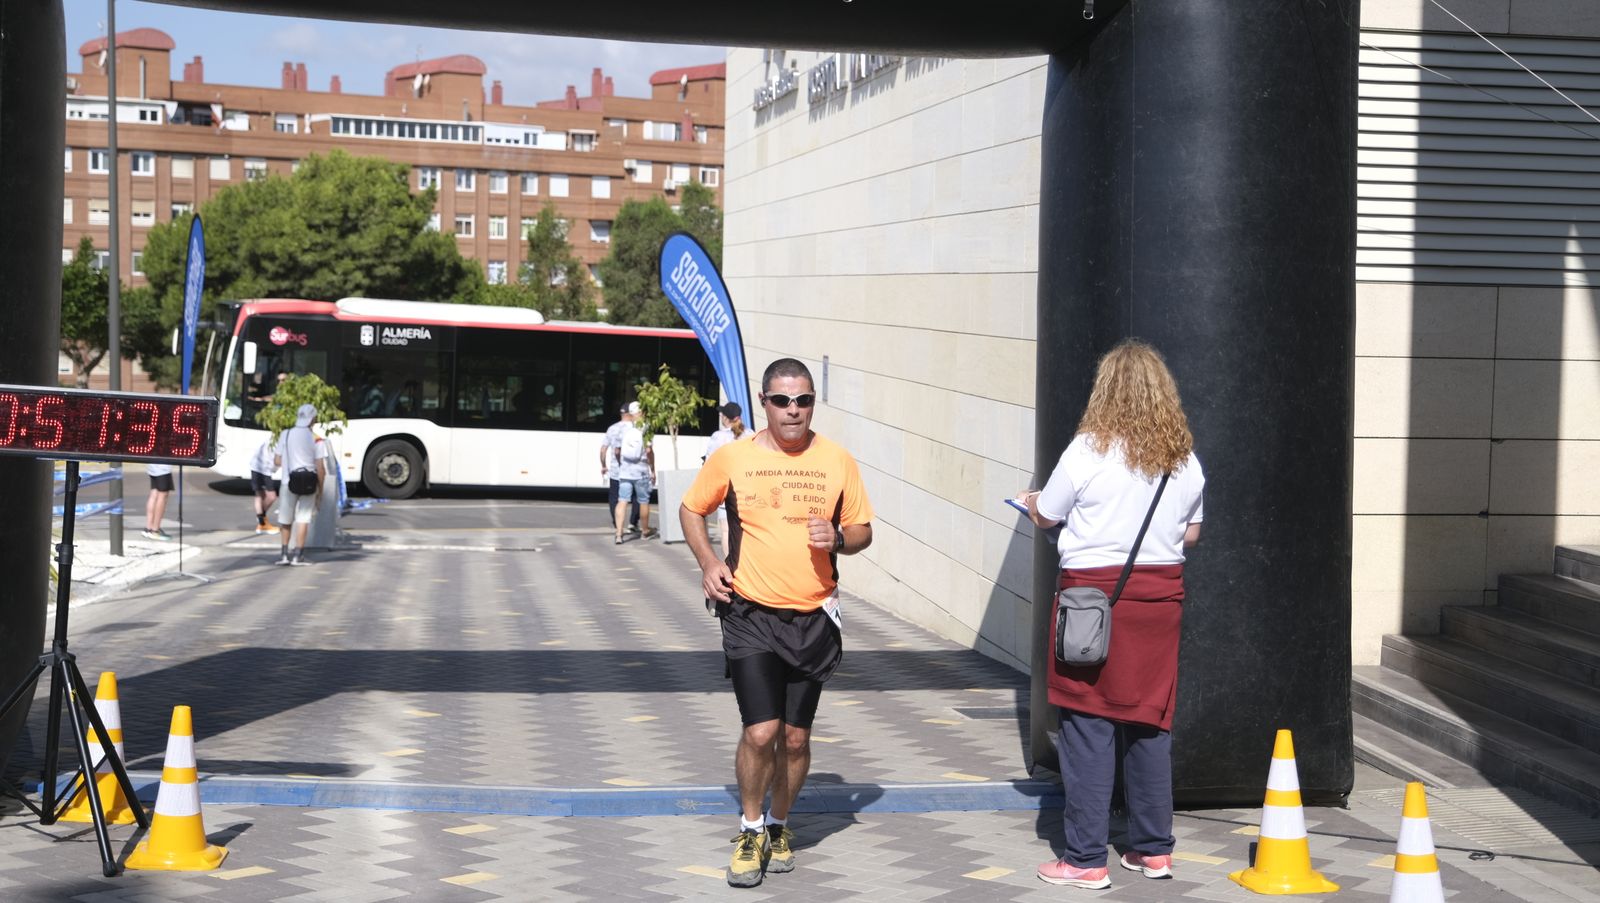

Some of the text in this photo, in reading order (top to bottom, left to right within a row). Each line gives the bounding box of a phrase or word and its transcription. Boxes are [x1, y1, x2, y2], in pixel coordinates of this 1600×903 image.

[382, 326, 432, 340] ALMERÍA
[745, 470, 753, 478] IV
[785, 470, 826, 479] MARATÓN
[782, 481, 826, 492] CIUDAD DE
[793, 494, 826, 505] EL EJIDO
[808, 506, 826, 516] 2011
